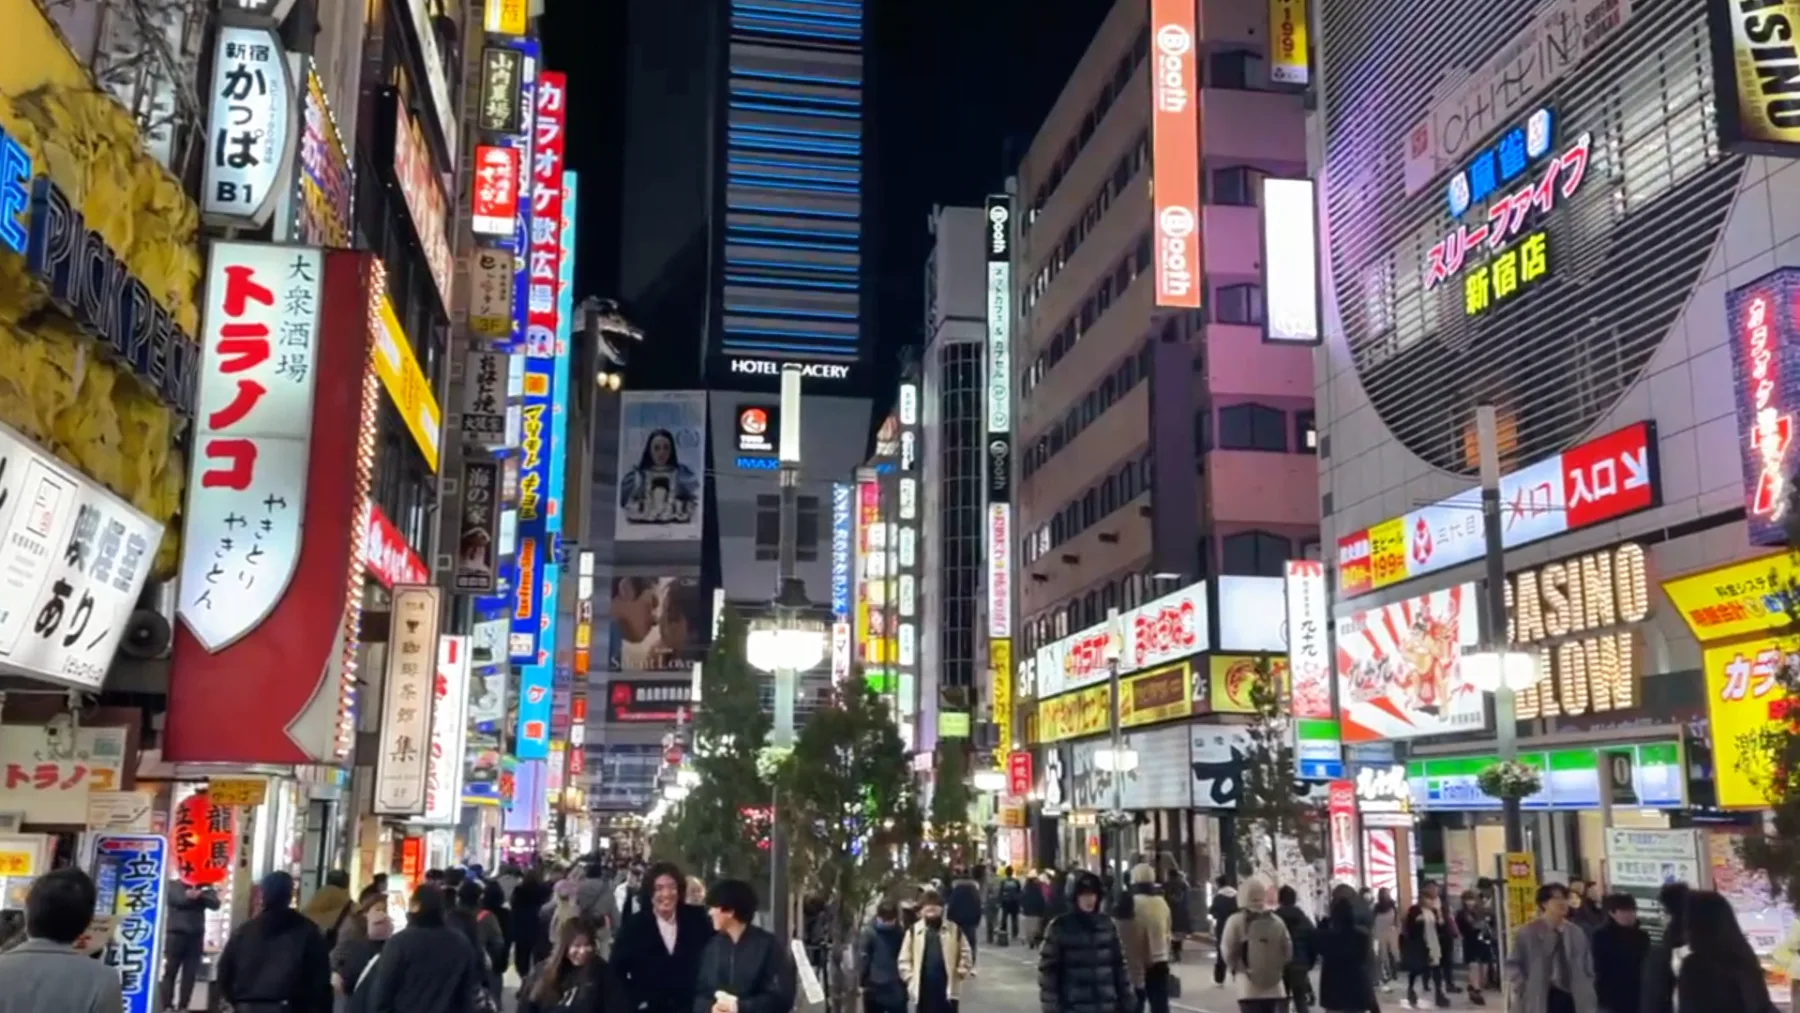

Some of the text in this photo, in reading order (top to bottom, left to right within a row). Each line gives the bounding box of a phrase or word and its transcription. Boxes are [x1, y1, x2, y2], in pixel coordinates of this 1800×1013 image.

[225, 42, 270, 62] 新宿
[1158, 24, 1190, 112] Booth
[214, 63, 268, 169] かっぱ
[216, 181, 254, 203] B1
[529, 81, 562, 314] カラオケ歌広場
[1424, 130, 1592, 290] スリーファイブ
[990, 205, 1008, 253] Booth
[1160, 205, 1196, 296] Booth
[1464, 230, 1547, 318] 新宿店
[275, 253, 316, 385] 大衆酒場
[200, 264, 276, 492] トラノコ
[731, 359, 780, 375] HOTEL
[737, 457, 779, 469] IMAX
[990, 440, 1008, 490] Booth
[466, 467, 489, 525] 海の家
[193, 512, 249, 611] やきとん
[237, 492, 288, 591] やきとり
[1301, 620, 1318, 658] 九十九
[1018, 657, 1036, 699] 3F
[1191, 671, 1208, 702] 2F
[5, 761, 115, 791] トラノコ
[389, 734, 419, 763] 集
[204, 804, 233, 869] 龍馬
